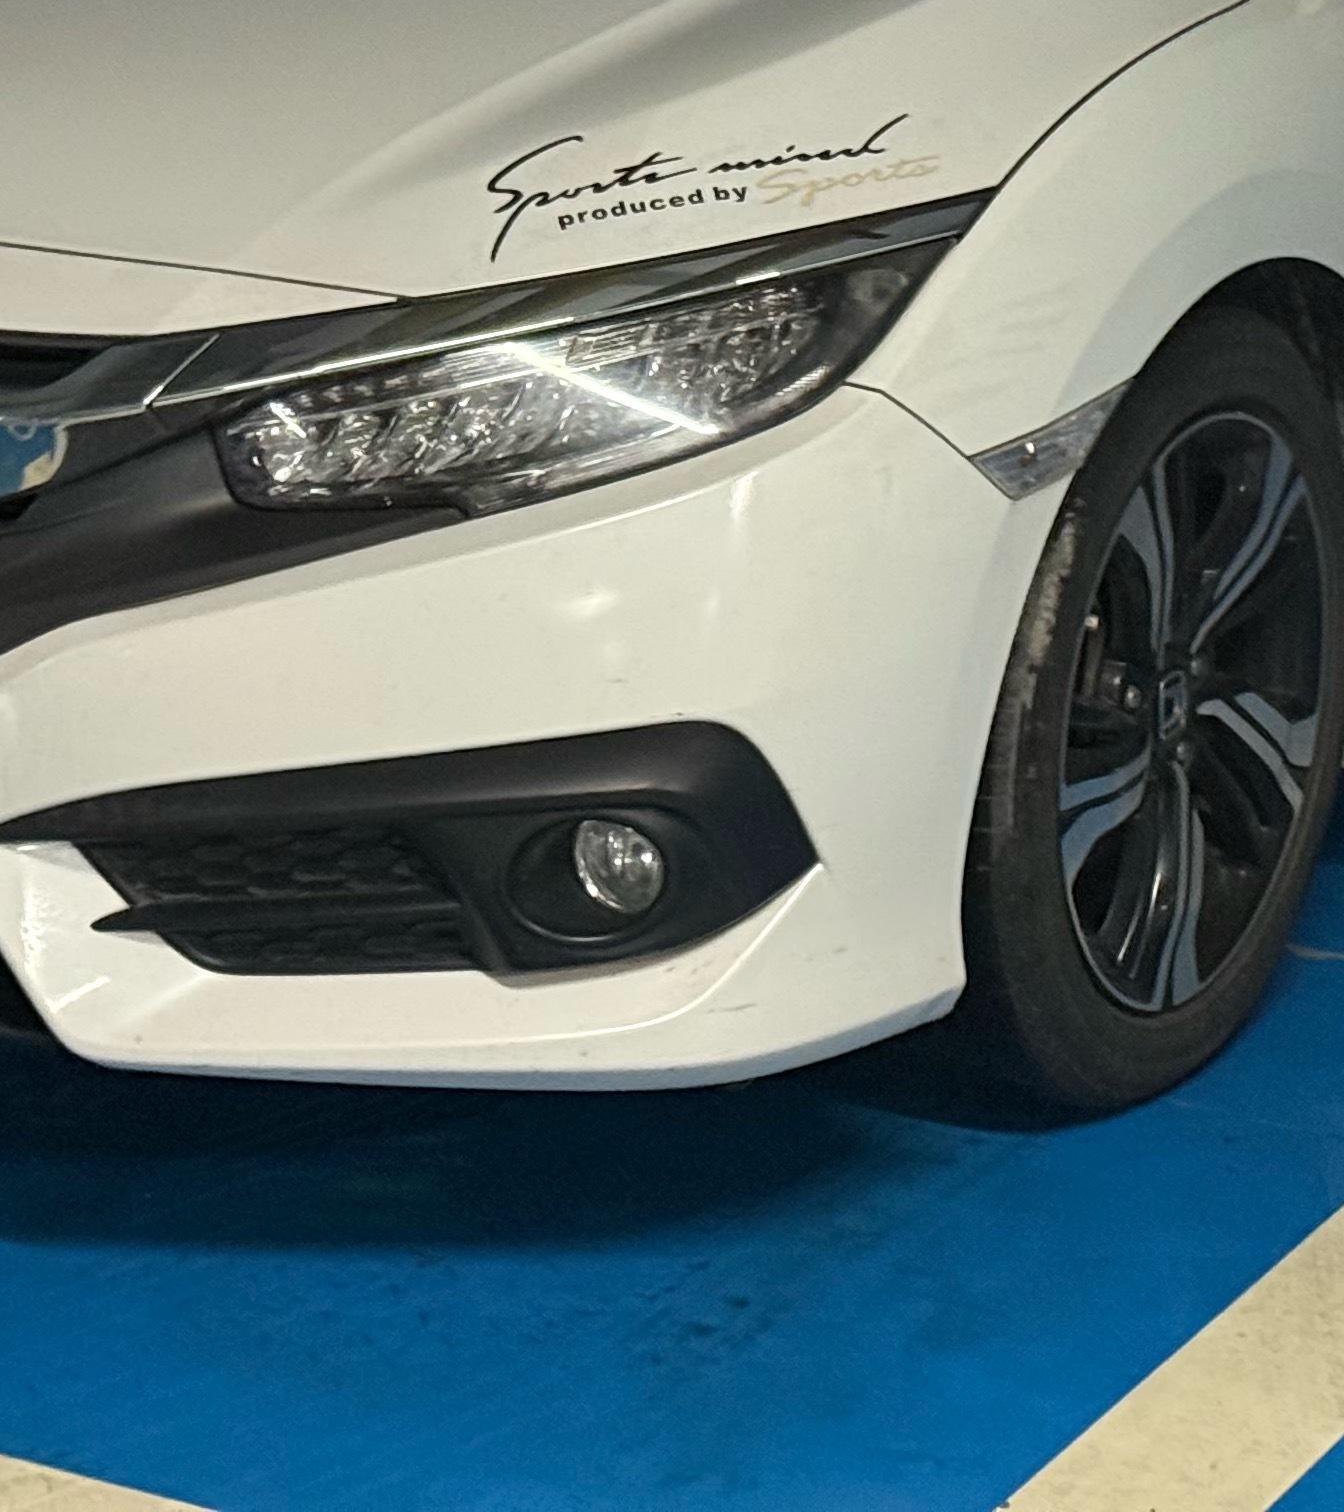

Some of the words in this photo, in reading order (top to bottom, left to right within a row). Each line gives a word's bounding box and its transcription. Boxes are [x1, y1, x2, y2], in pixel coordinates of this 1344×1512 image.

[557, 190, 705, 230] produced
[712, 184, 749, 204] by
[757, 154, 942, 207] Sports
